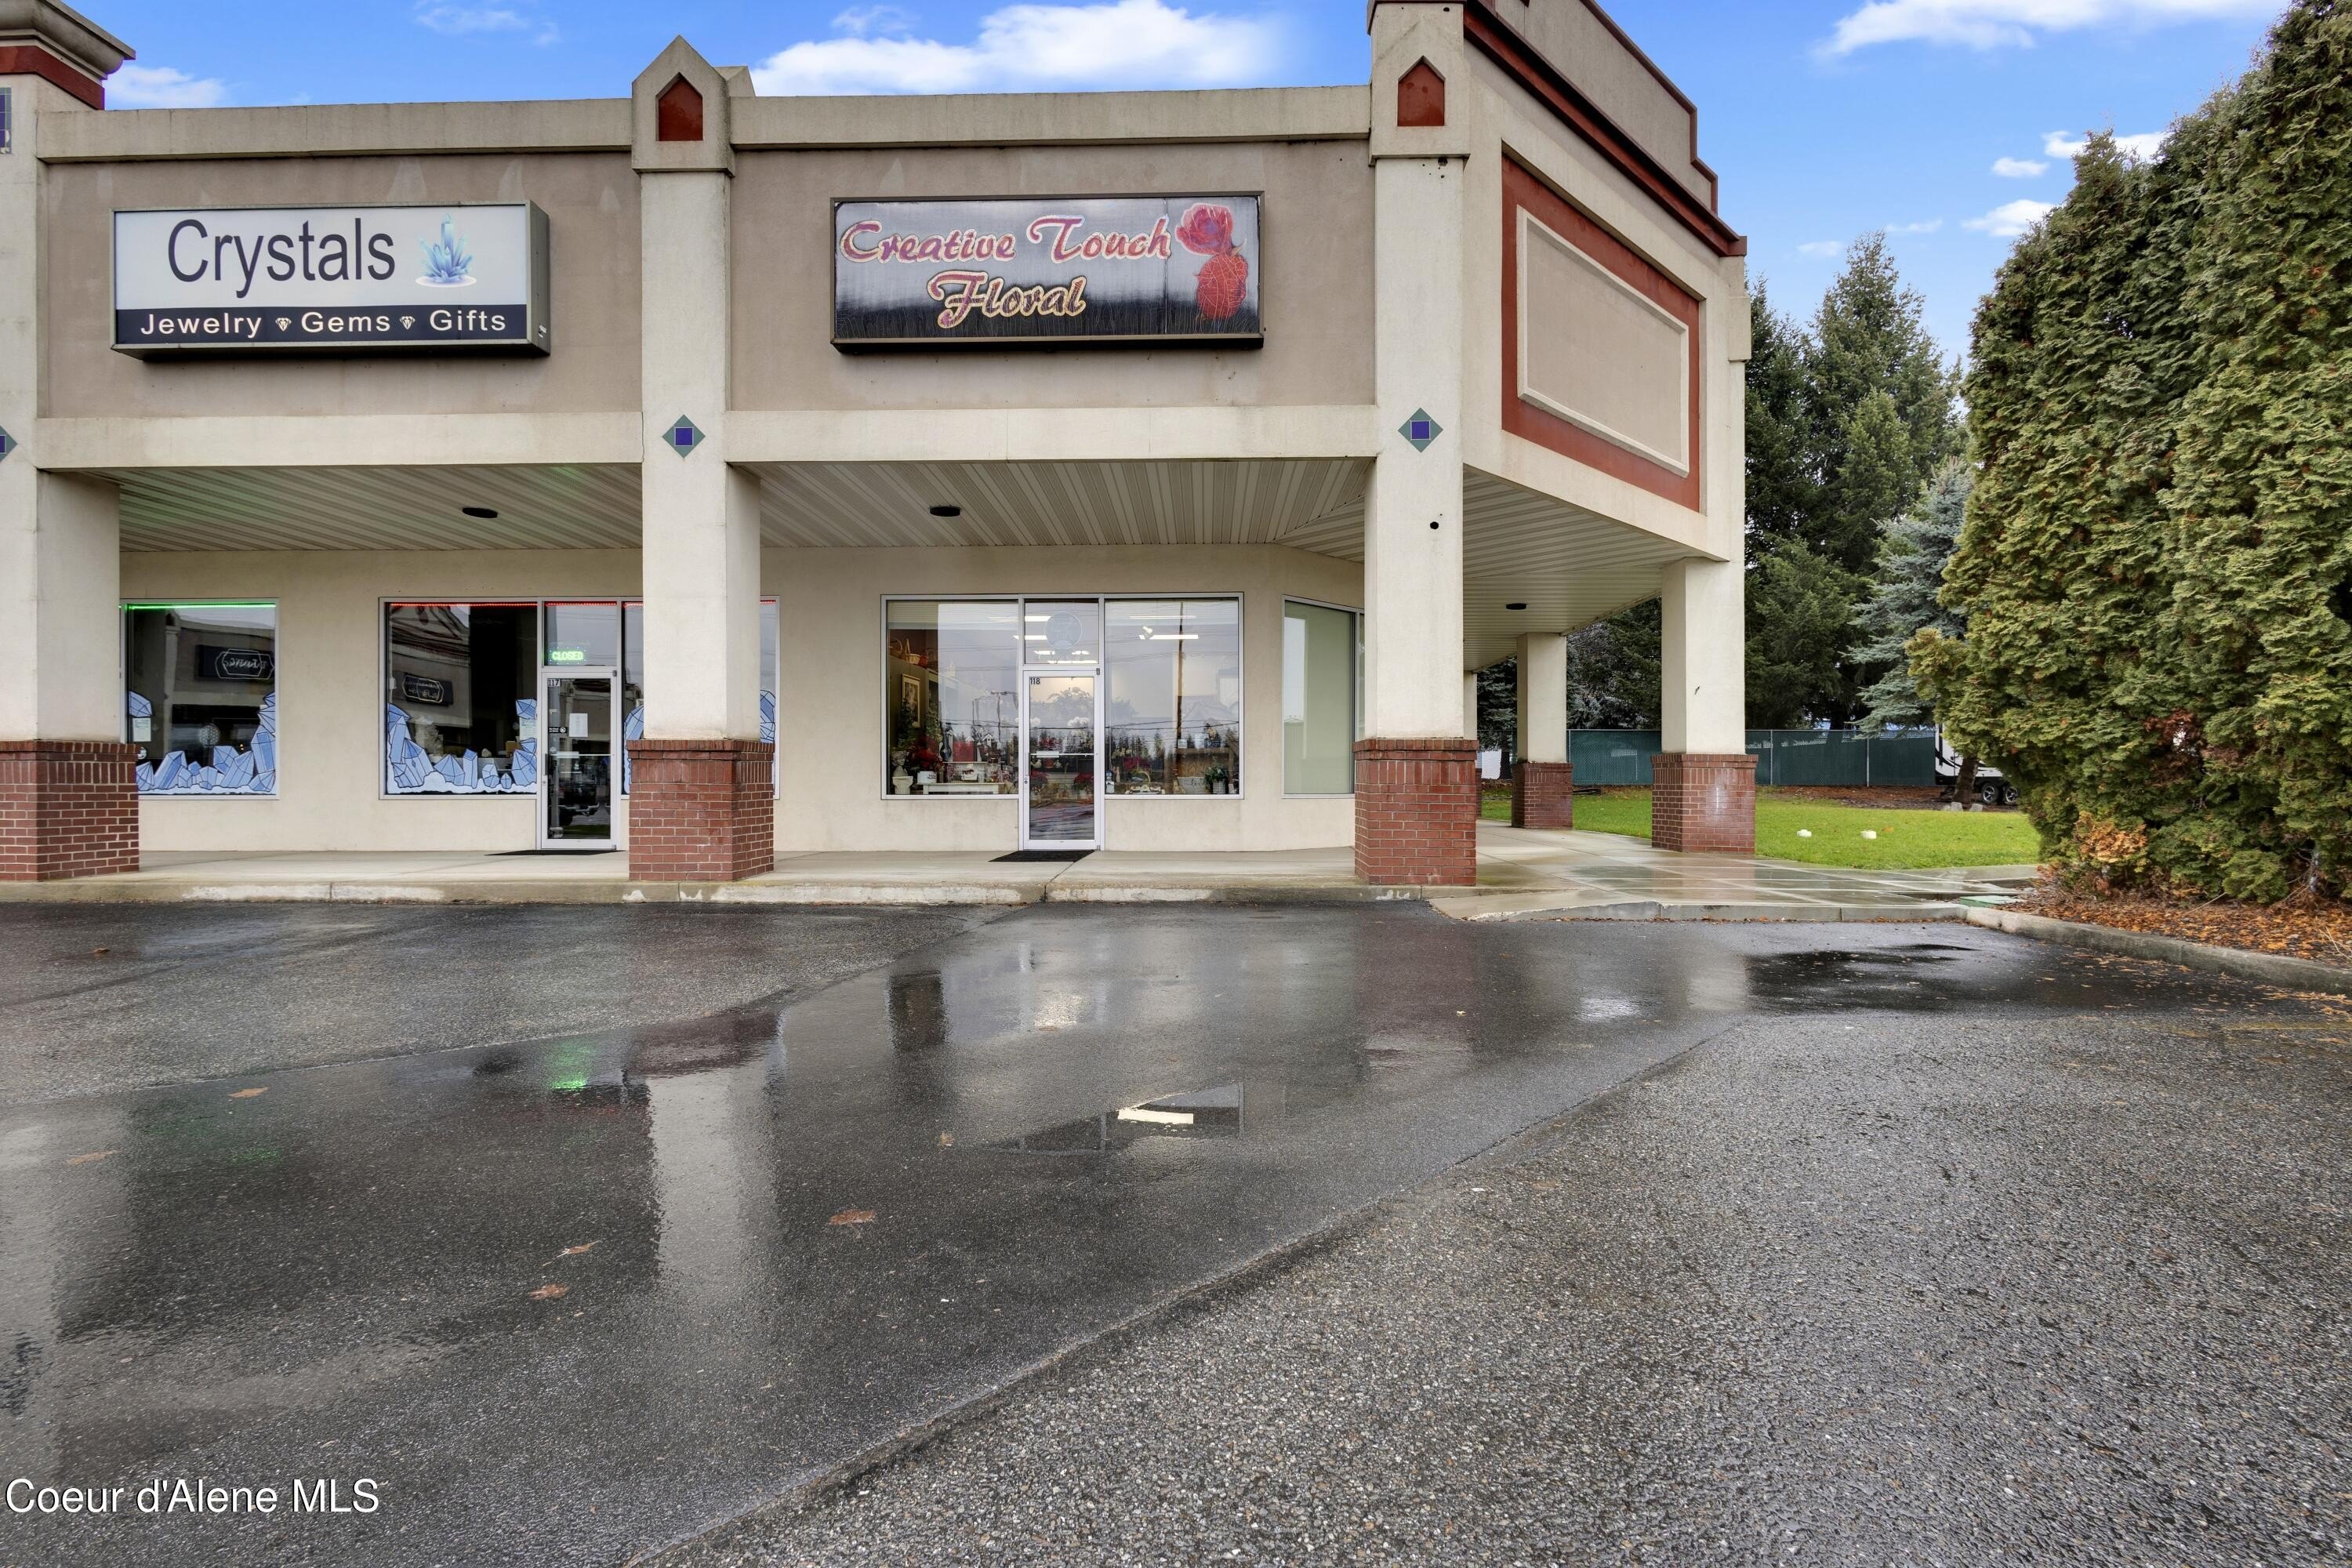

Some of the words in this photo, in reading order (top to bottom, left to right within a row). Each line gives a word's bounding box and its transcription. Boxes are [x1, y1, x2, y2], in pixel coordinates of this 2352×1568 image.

[168, 217, 395, 299] Crystals
[840, 219, 1017, 263] Creative
[1027, 213, 1171, 264] Touch
[140, 312, 263, 339] Jewelry
[301, 311, 391, 333] Gems
[429, 309, 506, 332] Gifts
[927, 270, 1087, 329] Floral
[552, 651, 583, 661] CLOSED
